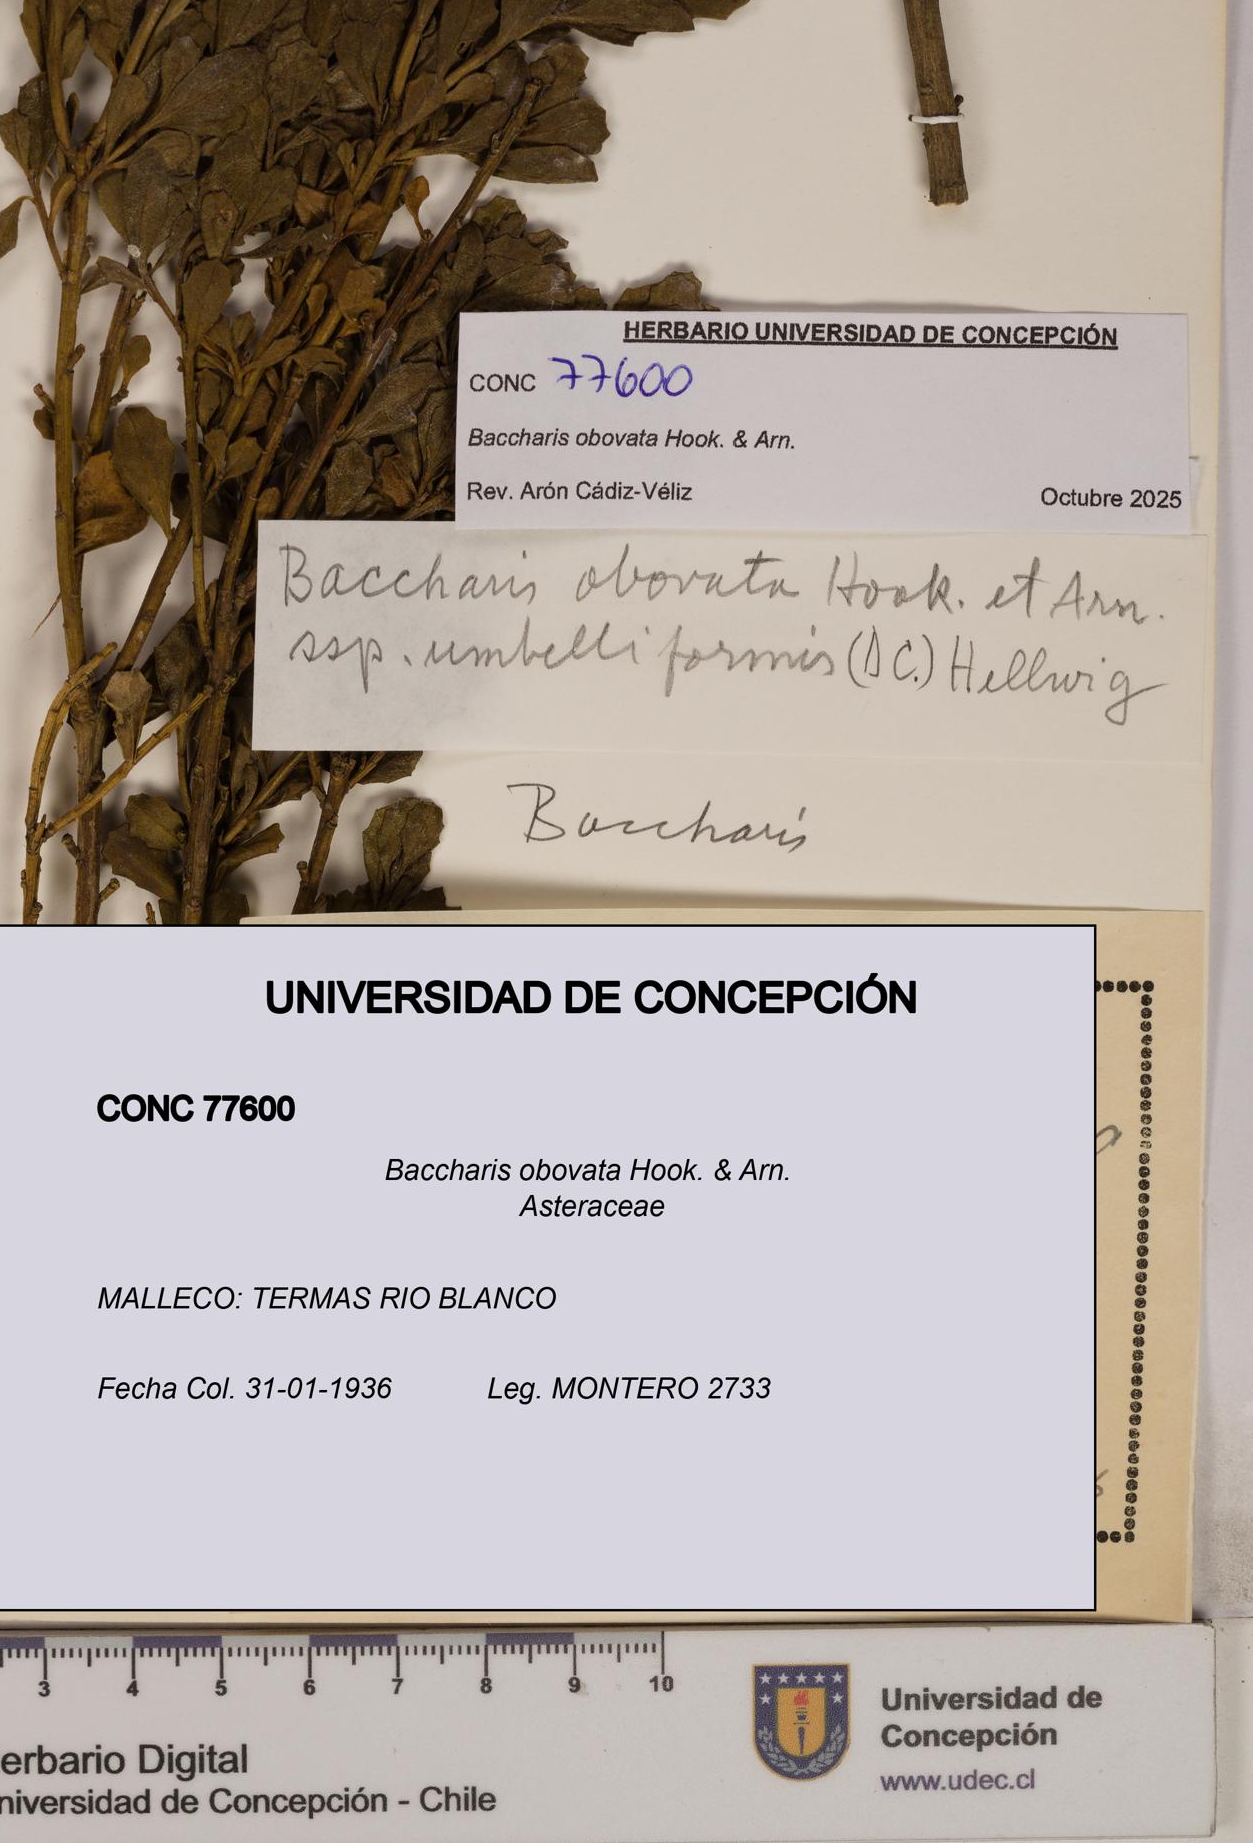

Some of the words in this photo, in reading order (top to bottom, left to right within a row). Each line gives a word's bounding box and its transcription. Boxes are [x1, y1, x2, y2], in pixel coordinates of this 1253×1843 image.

[623, 320, 749, 341] HERBARIO
[755, 320, 916, 344] UNIVERSIDAD
[922, 321, 955, 345] DE
[962, 321, 1119, 348] CONCEPCIÓN
[469, 373, 536, 393] CONC
[551, 354, 693, 398] 77600
[467, 427, 570, 447] Baccharis
[575, 427, 659, 447] obovata
[664, 428, 724, 449] Hook.
[732, 429, 748, 449] &
[753, 430, 795, 450] Arn.
[467, 481, 513, 501] Rev.
[519, 481, 569, 501] Arón
[575, 480, 693, 501] Cádiz-Véliz
[1040, 486, 1123, 508] Octubre
[1129, 489, 1182, 509] 2025
[280, 542, 537, 608] Baccharis
[575, 542, 800, 603] obovata
[984, 555, 1042, 619] et
[1049, 570, 1164, 626] Arn.
[288, 629, 411, 693] ssp.
[949, 633, 1172, 725] Hellwig
[506, 782, 807, 853] Baccharis
[38, 1679, 51, 1698] 3
[125, 1678, 140, 1697] 4
[214, 1677, 228, 1697] 5
[302, 1677, 316, 1696] 6
[391, 1676, 404, 1695] 7
[479, 1675, 493, 1695] 8
[567, 1674, 582, 1694] 9
[649, 1674, 674, 1693] 10
[881, 1685, 1058, 1712] Universidad
[1066, 1684, 1103, 1709] de
[880, 1721, 1058, 1753] Concepción
[138, 1743, 248, 1782] Digital
[879, 1767, 1036, 1792] www.udec.cl
[160, 1788, 199, 1815] de
[208, 1786, 388, 1820] Concepción
[419, 1785, 497, 1813] Chile
